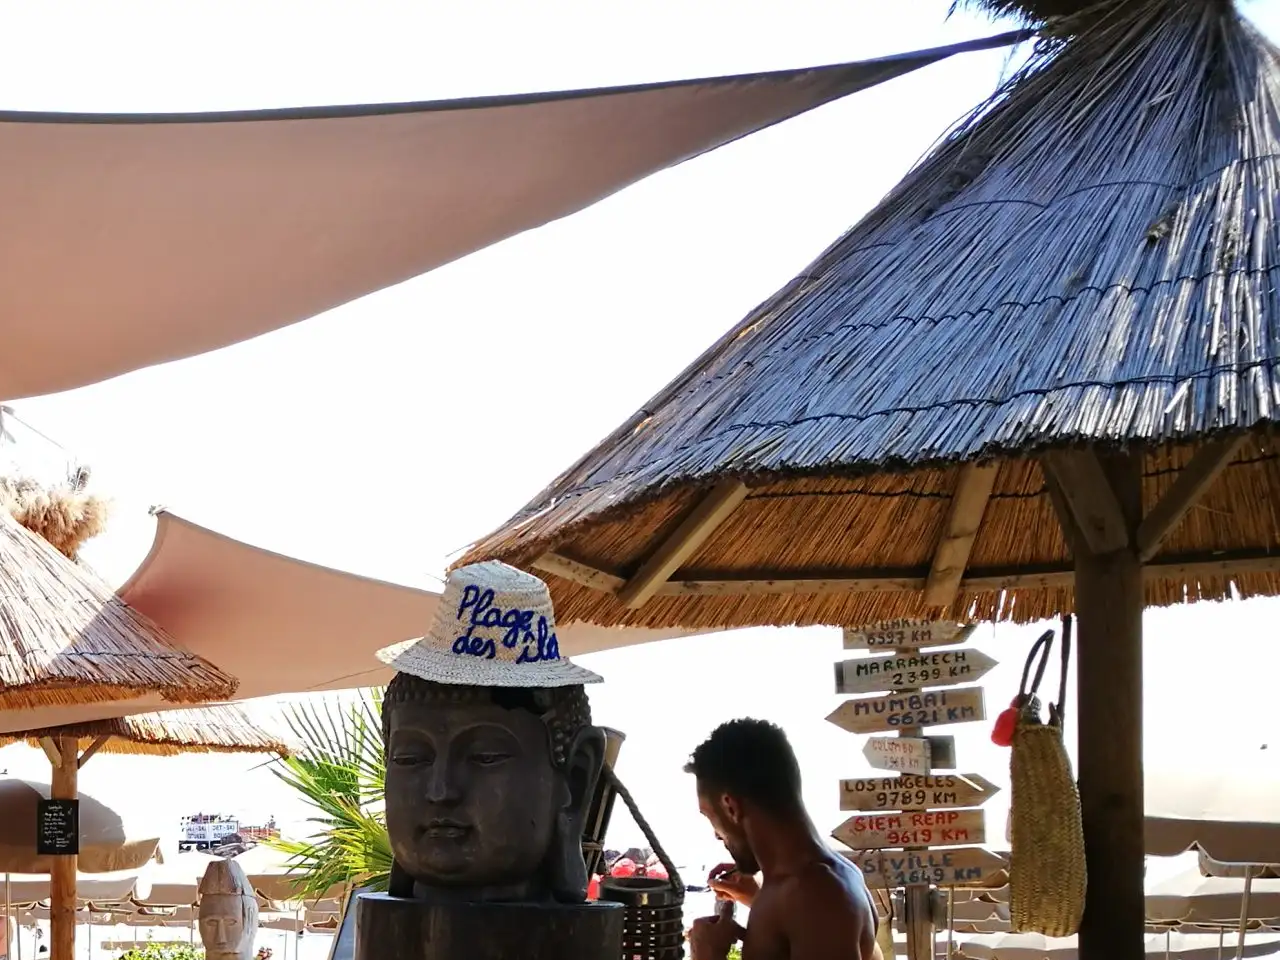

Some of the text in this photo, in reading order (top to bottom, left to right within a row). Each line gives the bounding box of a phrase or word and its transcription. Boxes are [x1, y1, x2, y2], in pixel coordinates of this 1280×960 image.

[457, 584, 534, 648] Plage
[452, 624, 496, 659] des
[911, 630, 931, 642] KM
[856, 651, 966, 676] MARRAKECH
[893, 664, 970, 685] 2399 KM
[887, 706, 975, 726] 6621 KM
[844, 775, 956, 792] LOS ANGELES
[876, 790, 957, 807] 9789 KM
[911, 812, 959, 826] REAP
[887, 829, 969, 844] 9619 KM
[954, 867, 982, 881] KM
